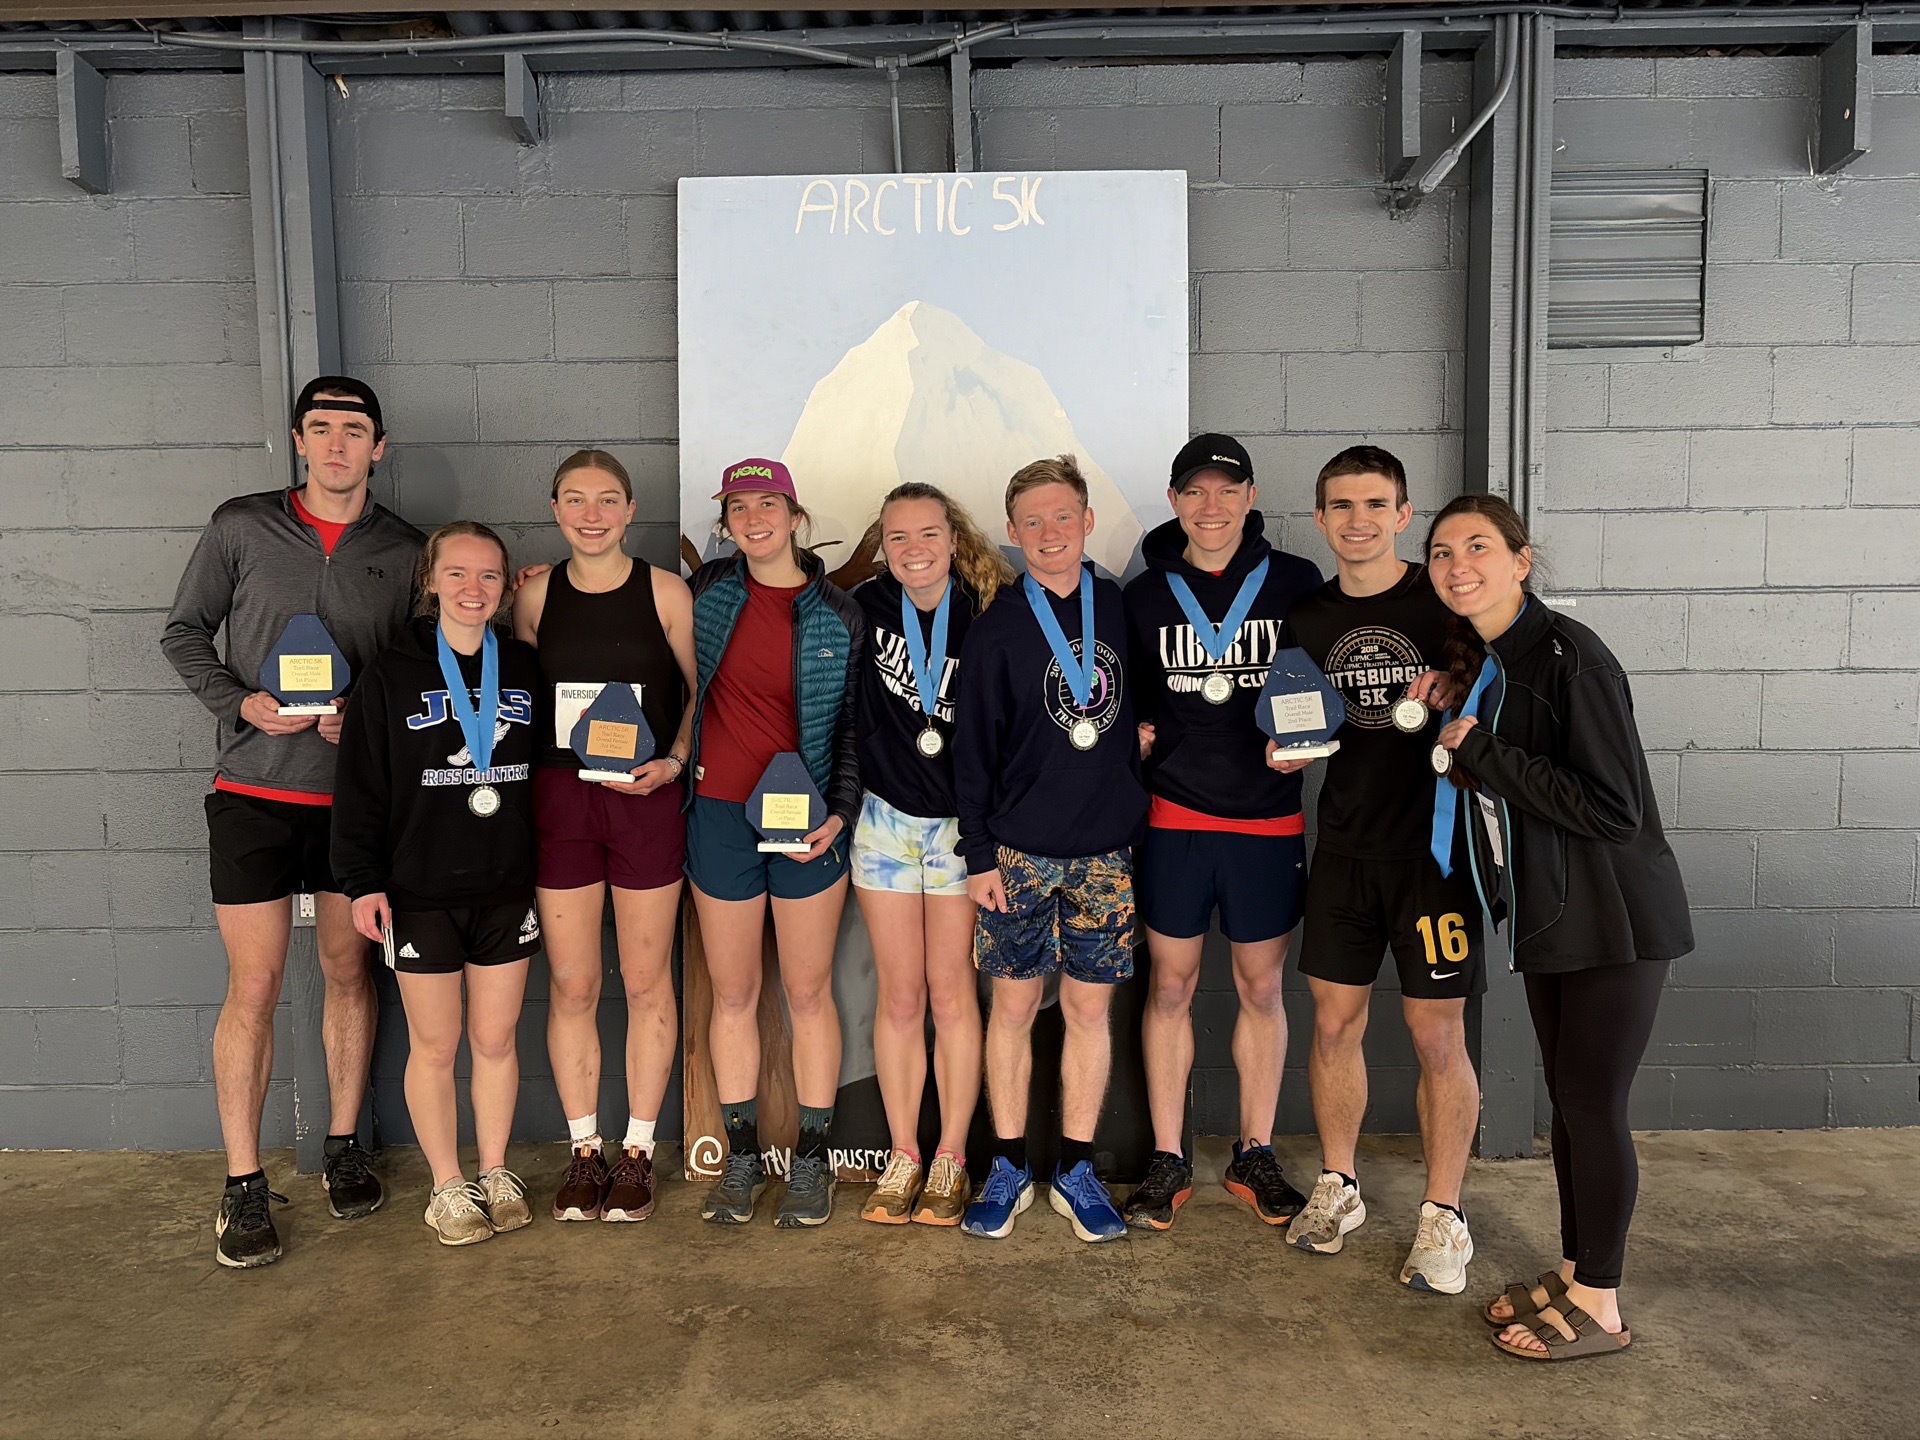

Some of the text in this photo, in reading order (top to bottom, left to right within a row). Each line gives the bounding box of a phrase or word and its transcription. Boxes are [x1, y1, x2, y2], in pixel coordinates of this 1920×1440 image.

[795, 176, 1045, 235] ARCTIC 5K
[729, 466, 773, 482] HOKA
[1360, 645, 1379, 654] 2019
[1350, 654, 1373, 663] UPMC
[1344, 662, 1362, 670] UPMC
[561, 689, 599, 699] RIVERSIDE
[1359, 688, 1390, 707] 5K
[1280, 697, 1304, 705] ARCTIC
[1416, 912, 1469, 965] 16
